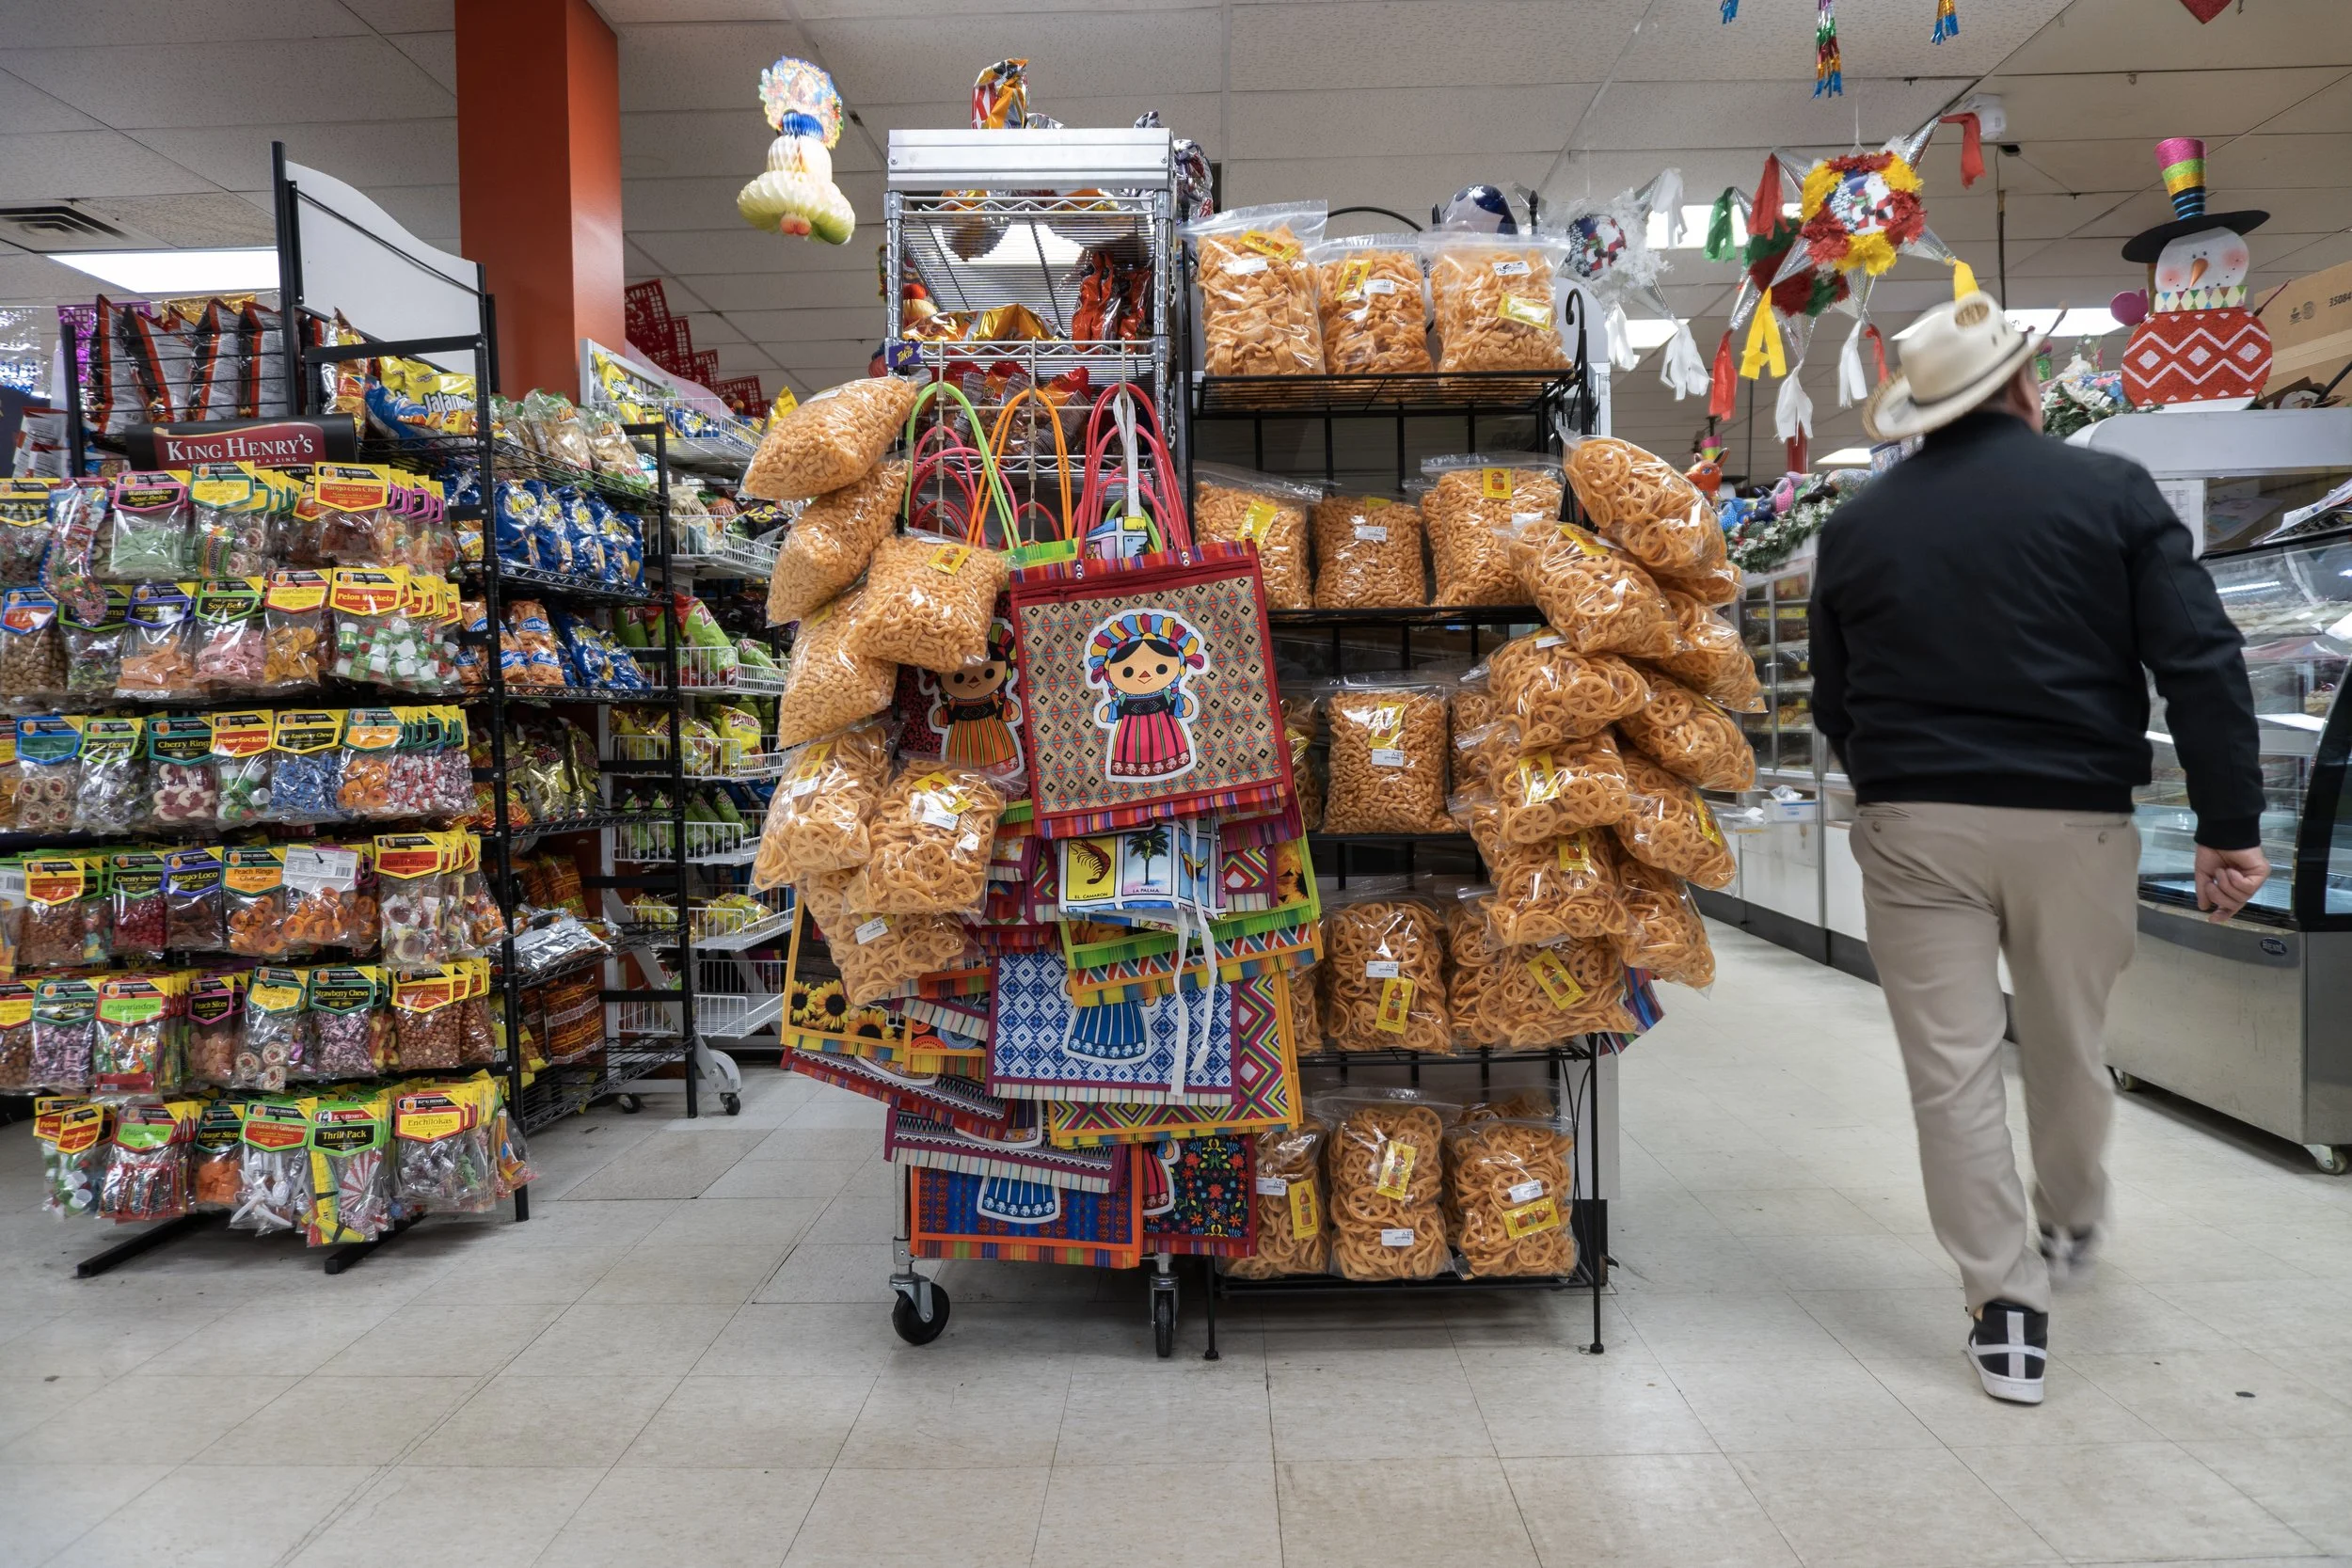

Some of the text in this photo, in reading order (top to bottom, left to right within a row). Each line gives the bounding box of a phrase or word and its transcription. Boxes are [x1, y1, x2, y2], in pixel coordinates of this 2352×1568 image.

[166, 433, 314, 462] KING HENRY'S
[157, 739, 187, 749] Cherry
[116, 875, 139, 883] Cherry
[171, 871, 218, 881] Mango Loco
[407, 1117, 453, 1128] Enchilokas
[324, 1130, 366, 1140] Thrill Pack
